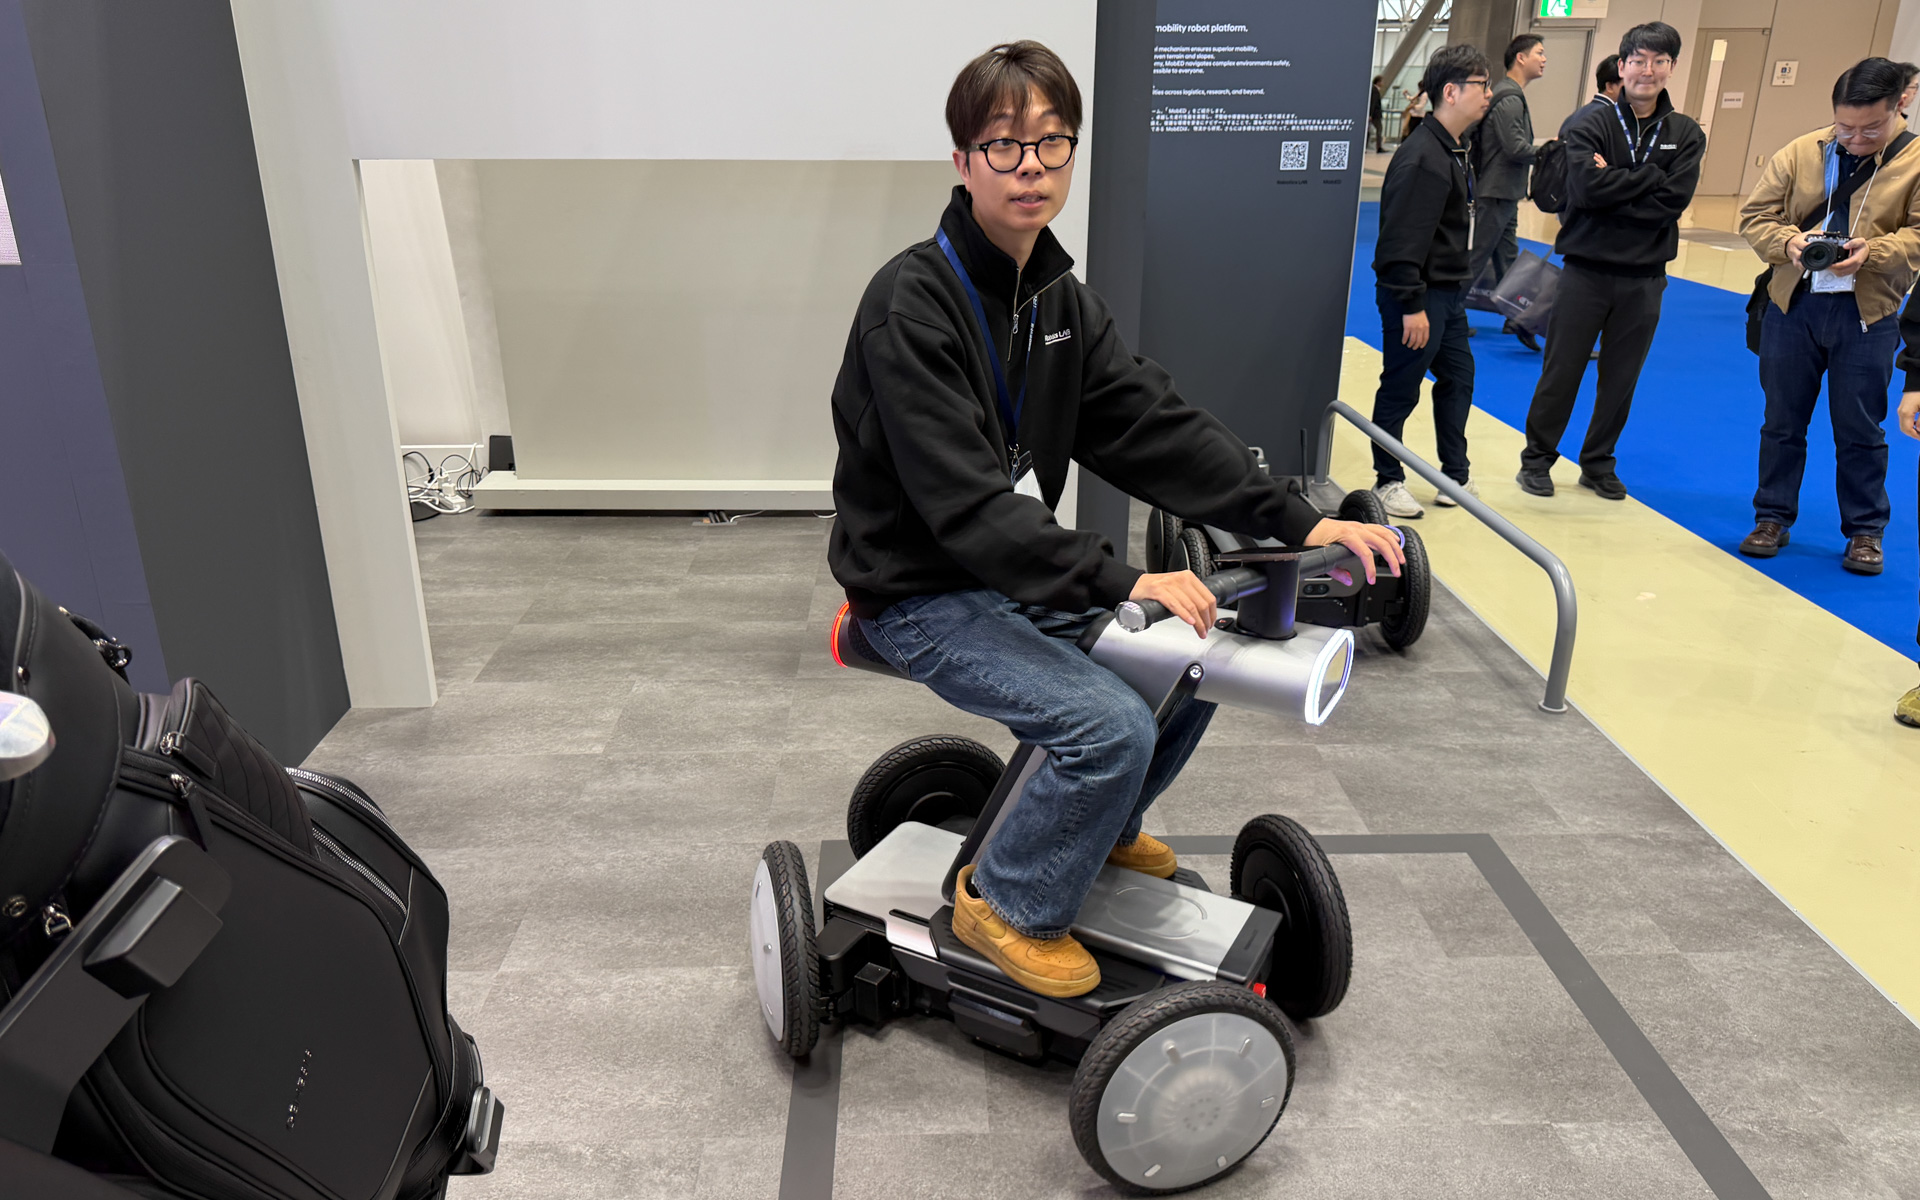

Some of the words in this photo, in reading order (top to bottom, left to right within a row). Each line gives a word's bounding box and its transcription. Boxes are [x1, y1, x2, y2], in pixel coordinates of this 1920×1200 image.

[1187, 23, 1210, 33] robot
[1210, 23, 1248, 33] platform.
[1234, 45, 1258, 53] mobility,
[1196, 53, 1215, 61] slopes.
[1272, 59, 1291, 67] safely,
[1182, 88, 1206, 96] logistics,
[1206, 88, 1231, 96] research,
[287, 1048, 312, 1129] GEESS
